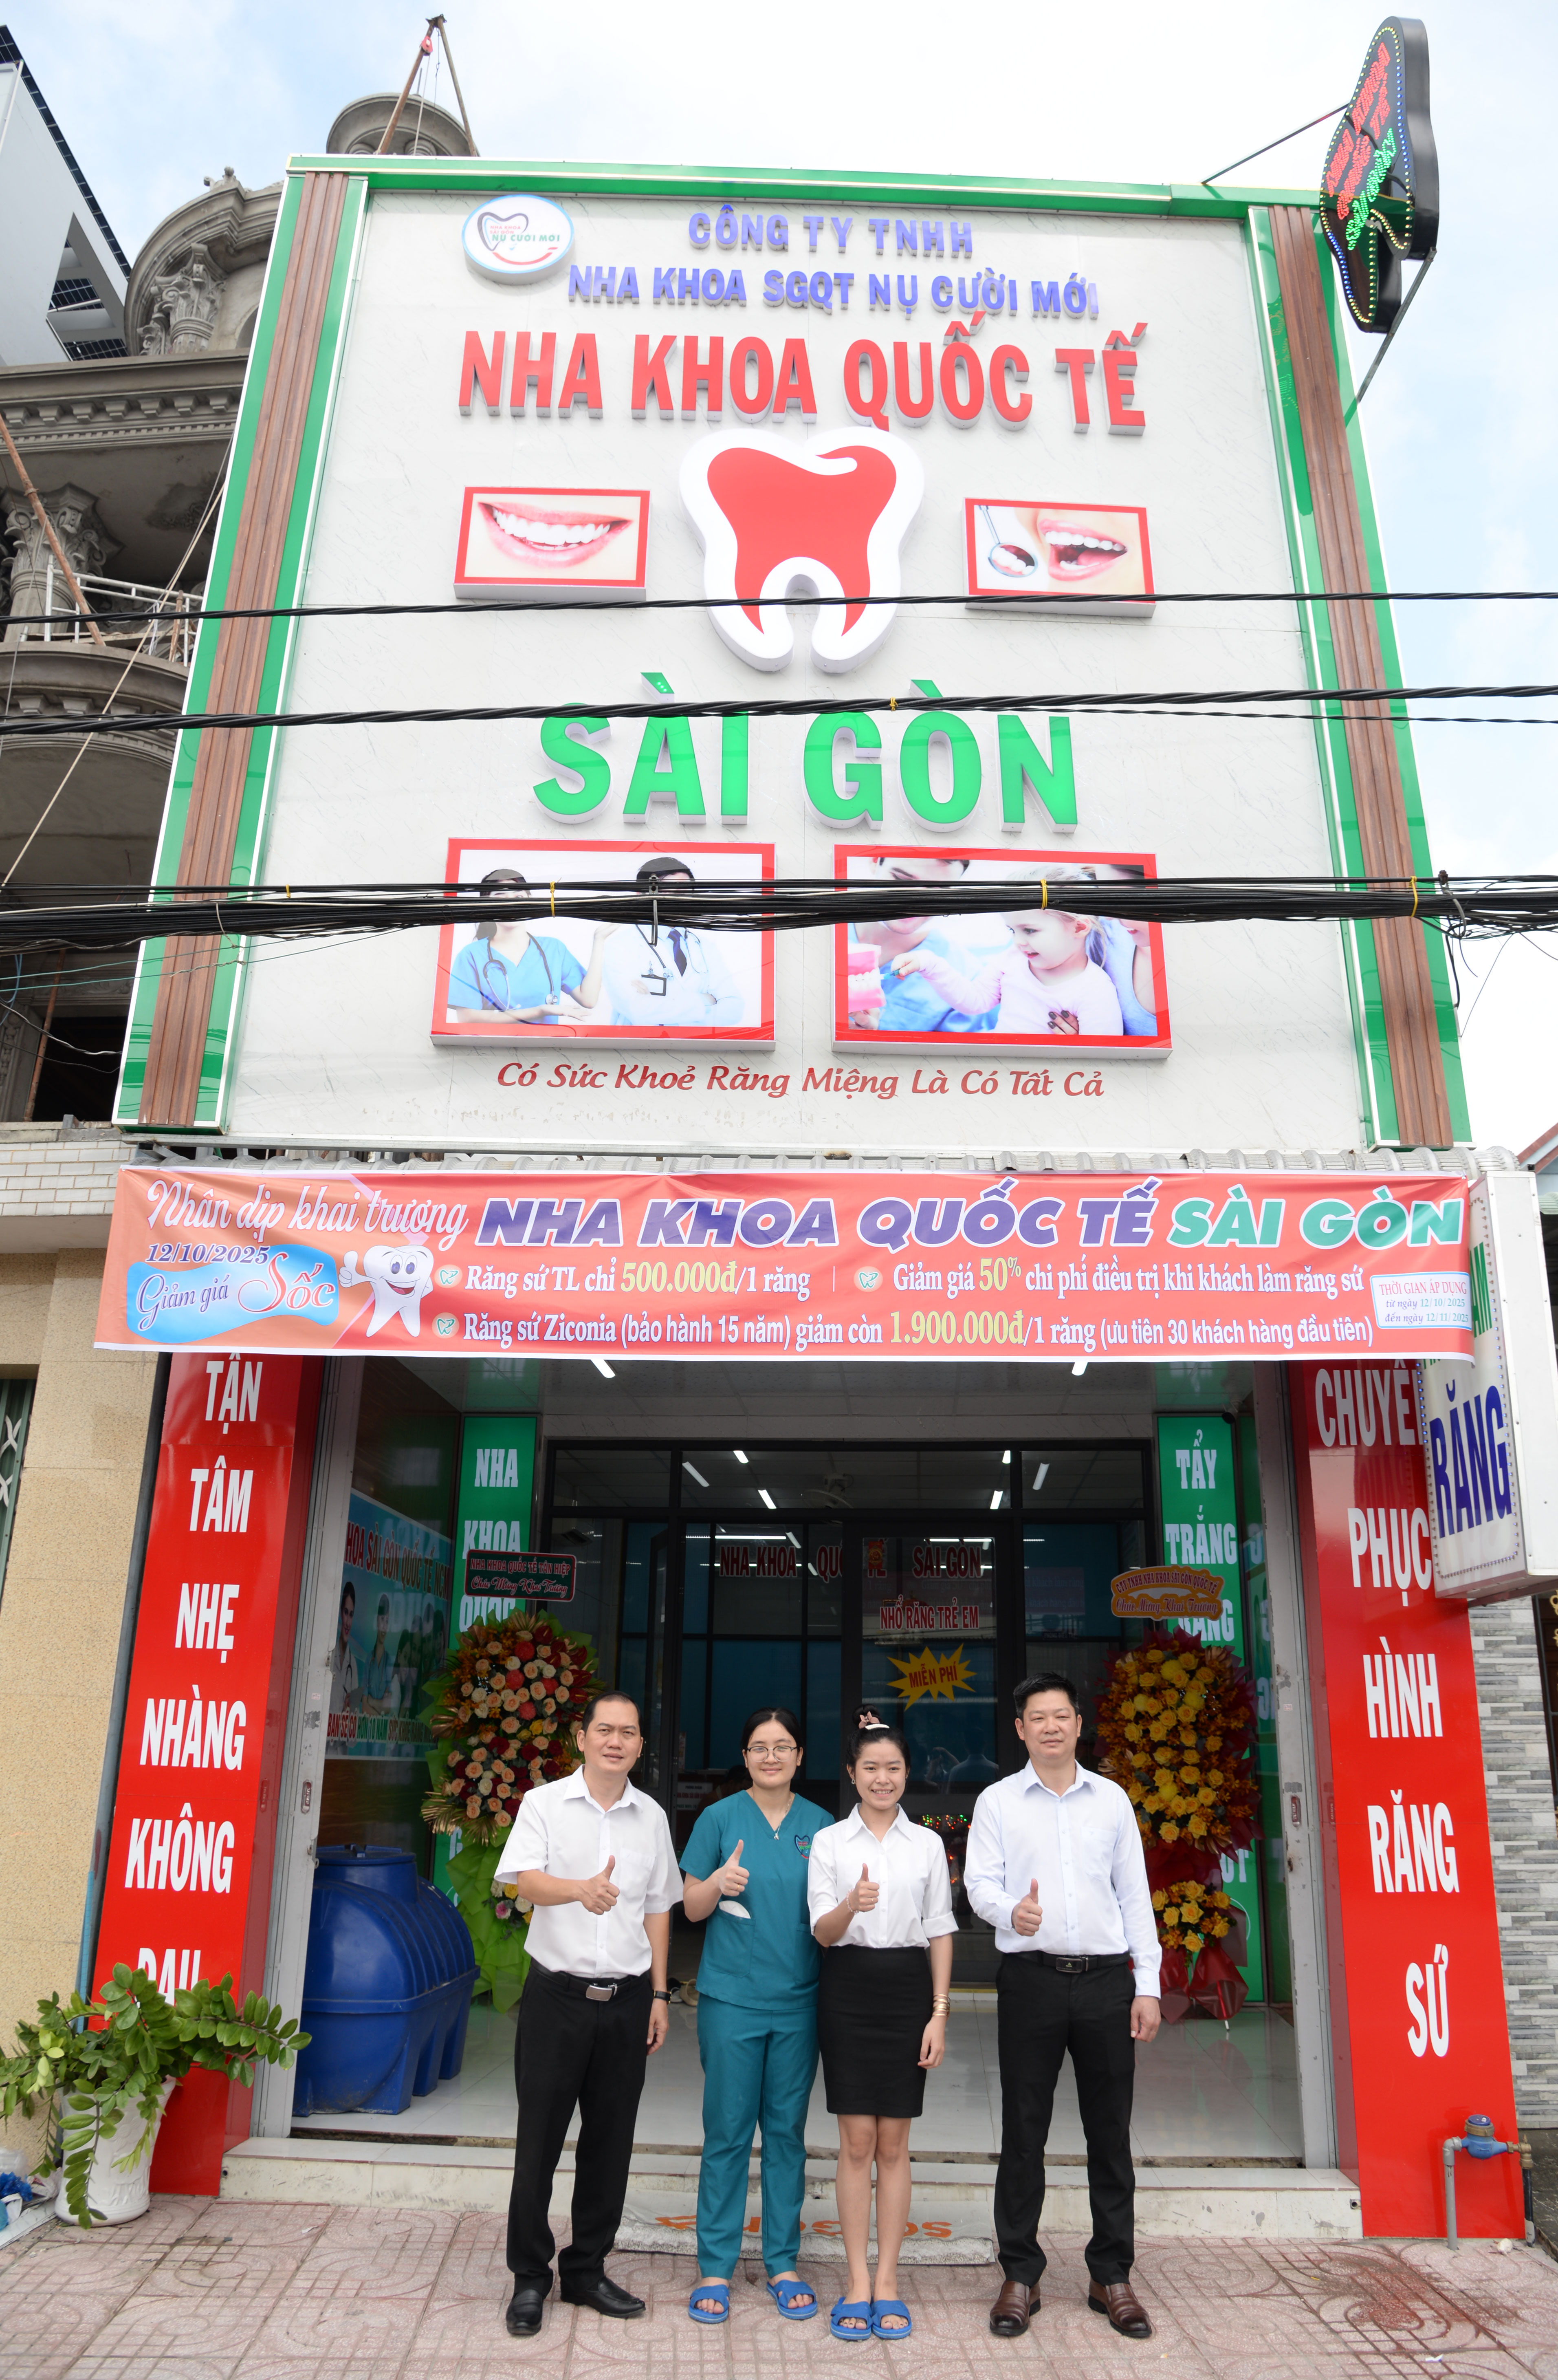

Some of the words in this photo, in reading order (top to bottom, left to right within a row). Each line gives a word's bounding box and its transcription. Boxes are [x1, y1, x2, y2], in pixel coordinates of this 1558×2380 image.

[492, 234, 506, 242] NỤ
[689, 205, 788, 251] CÔNG
[803, 216, 853, 252] TY
[868, 218, 973, 258] TNHH
[569, 265, 638, 304] NHA
[653, 267, 746, 306] KHOA
[763, 270, 854, 314] SGQT
[869, 273, 918, 319] NỤ
[932, 265, 1017, 316] CƯỜI
[1031, 272, 1099, 318] MỚI
[458, 331, 603, 417] NHA
[631, 334, 818, 423] KHOA
[843, 311, 1033, 432] QUỐC
[1055, 323, 1148, 434] TẾ
[533, 672, 748, 824] SÀI
[804, 679, 1078, 833] GÒN
[497, 1062, 537, 1087] Có
[547, 1063, 608, 1089] Sức
[615, 1064, 695, 1090] Khoẻ
[707, 1066, 790, 1098] Răng
[802, 1067, 899, 1100] Miệng
[911, 1069, 949, 1095] Là
[961, 1069, 998, 1095] Có
[1010, 1069, 1053, 1096] Tất
[1064, 1071, 1104, 1097] Cả
[147, 1179, 231, 1230] Nhân
[235, 1183, 285, 1243] dịp
[288, 1186, 361, 1232] khai
[363, 1190, 469, 1252] trương
[475, 1198, 623, 1247] NHA
[637, 1198, 840, 1248] KHOA
[857, 1176, 1065, 1254] QUỐC
[1078, 1176, 1160, 1249] TẾ
[1168, 1183, 1285, 1249] SÀI
[1299, 1185, 1465, 1251] GÒN
[146, 1243, 271, 1265] 12/10/2025
[467, 1264, 519, 1299] Răng
[523, 1261, 551, 1292] sứ
[552, 1268, 579, 1292] TL
[584, 1256, 616, 1293] chỉ
[763, 1267, 810, 1301] răng
[893, 1261, 943, 1293] Giảm
[946, 1261, 975, 1300] giá
[979, 1257, 1022, 1291] 50%
[1025, 1263, 1054, 1292] chi
[1057, 1254, 1088, 1300] phí
[1092, 1257, 1133, 1292] điều
[1136, 1262, 1160, 1299] trị
[1163, 1262, 1194, 1293] khi
[1198, 1260, 1255, 1294] khách
[1259, 1262, 1292, 1294] làm
[1295, 1265, 1337, 1300] răng
[1341, 1265, 1364, 1292] sứ
[136, 1274, 196, 1331] Giảm
[200, 1274, 229, 1313] giá
[237, 1254, 334, 1312] Sốc
[1379, 1280, 1402, 1295] THỜI
[1404, 1282, 1426, 1294] GIAN
[1430, 1278, 1439, 1294] ÁP
[1442, 1282, 1467, 1296] DỤNG
[1398, 1299, 1417, 1309] ngày
[464, 1313, 513, 1349] Răng
[516, 1310, 541, 1343] sứ
[544, 1314, 617, 1342] Ziconia
[621, 1310, 662, 1349] (bảo
[666, 1314, 712, 1343] hành
[717, 1316, 738, 1342] 15
[744, 1314, 791, 1350] năm)
[796, 1313, 845, 1353] giảm
[849, 1314, 882, 1344] còn
[1050, 1316, 1096, 1353] răng
[1100, 1320, 1129, 1350] (ưu
[1131, 1318, 1164, 1345] tiên
[1167, 1320, 1188, 1344] 30
[1191, 1318, 1244, 1344] khách
[1248, 1318, 1295, 1349] hàng
[1298, 1314, 1329, 1345] đầu
[1332, 1316, 1374, 1347] tiên)
[1385, 1312, 1401, 1322] đến
[1403, 1313, 1423, 1324] ngày
[205, 1353, 262, 1434] TẬN
[1315, 1360, 1424, 1448] CHUYÊ
[475, 1448, 519, 1488] NHA
[1175, 1429, 1217, 1489] TẨY
[1429, 1379, 1513, 1539] RĂNG
[190, 1455, 253, 1533] TÂM
[345, 1521, 365, 1570] HOA
[366, 1522, 383, 1576] SÀI
[383, 1529, 401, 1582] GÒN
[401, 1538, 423, 1592] QUỐC
[423, 1545, 436, 1594] TẾ
[462, 1520, 521, 1560] KHOA
[912, 1539, 943, 1578] SÀI
[945, 1539, 981, 1578] GÒN
[1165, 1505, 1237, 1565] TRẮNG
[1348, 1508, 1432, 1606] PHỤC
[470, 1558, 486, 1571] NHA
[486, 1559, 506, 1571] KHOA
[508, 1556, 526, 1574] QUỐC
[528, 1556, 537, 1573] TẾ
[538, 1560, 552, 1574] TÂN
[554, 1561, 571, 1578] HIỆP
[471, 1575, 491, 1590] Chúc
[519, 1578, 541, 1594] Khai
[719, 1545, 750, 1577] NHA
[756, 1545, 798, 1578] KHOA
[816, 1544, 842, 1583] QU
[1116, 1578, 1127, 1594] CTY
[1128, 1573, 1142, 1589] TNHH
[1143, 1572, 1155, 1584] NHA
[1156, 1571, 1170, 1583] KHOA
[1171, 1569, 1180, 1584] SÀI
[1181, 1570, 1193, 1586] GÒN
[1193, 1573, 1208, 1591] QUỐC
[1209, 1581, 1220, 1595] TẾ
[175, 1583, 240, 1663] NHẸ
[880, 1594, 903, 1630] NHỔ
[905, 1602, 936, 1630] RĂNG
[936, 1597, 959, 1629] TRẺ
[962, 1605, 979, 1629] EM
[1162, 1598, 1185, 1613] Khai
[909, 1660, 937, 1688] MIỄN
[938, 1661, 958, 1684] PHÍ
[1363, 1636, 1443, 1738] HÌNH
[140, 1684, 247, 1771] NHÀNG
[327, 1713, 341, 1745] BẠN
[125, 1803, 235, 1894] KHÔNG
[1367, 1789, 1460, 1893] RĂNG
[1405, 1944, 1449, 2058] SỨ
